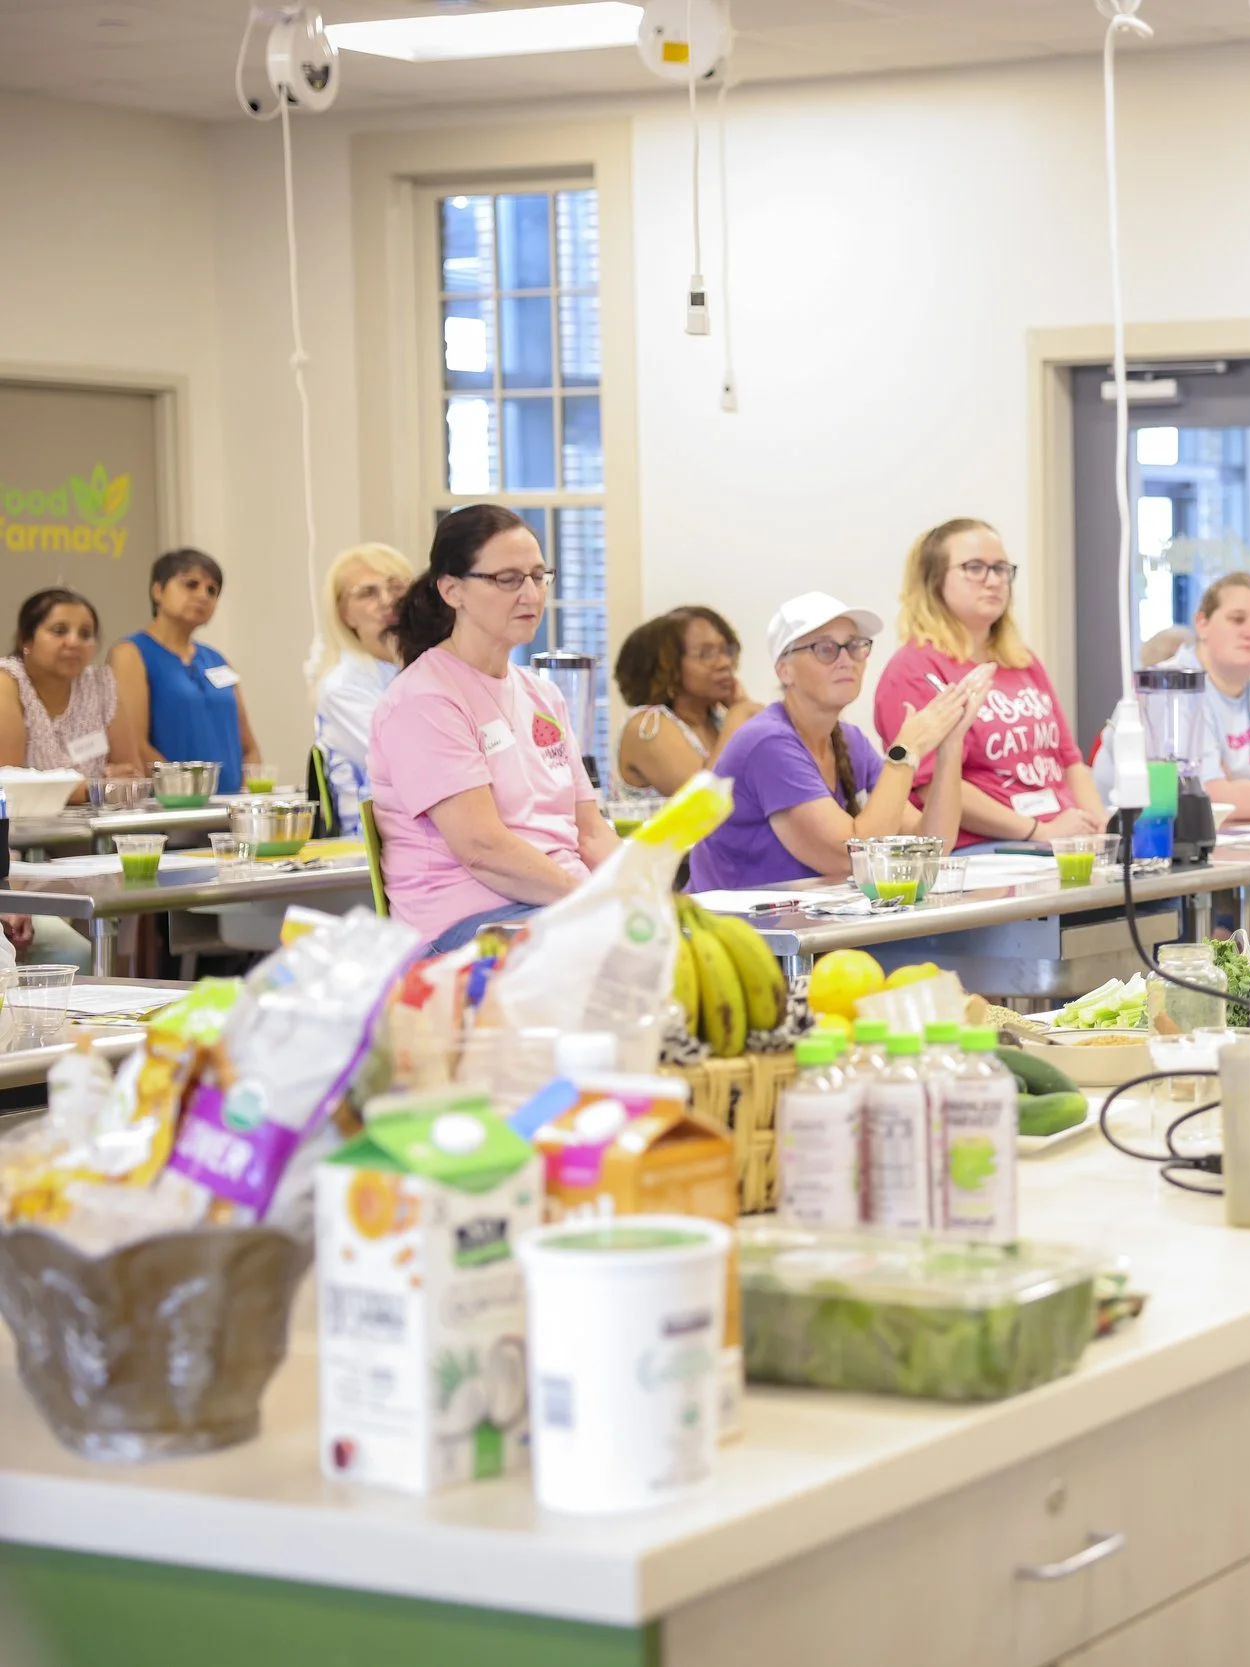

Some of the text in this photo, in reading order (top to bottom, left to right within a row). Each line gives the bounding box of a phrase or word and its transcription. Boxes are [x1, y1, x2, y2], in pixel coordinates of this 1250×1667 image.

[0, 477, 69, 519] ood
[985, 721, 1060, 761] CAT MO
